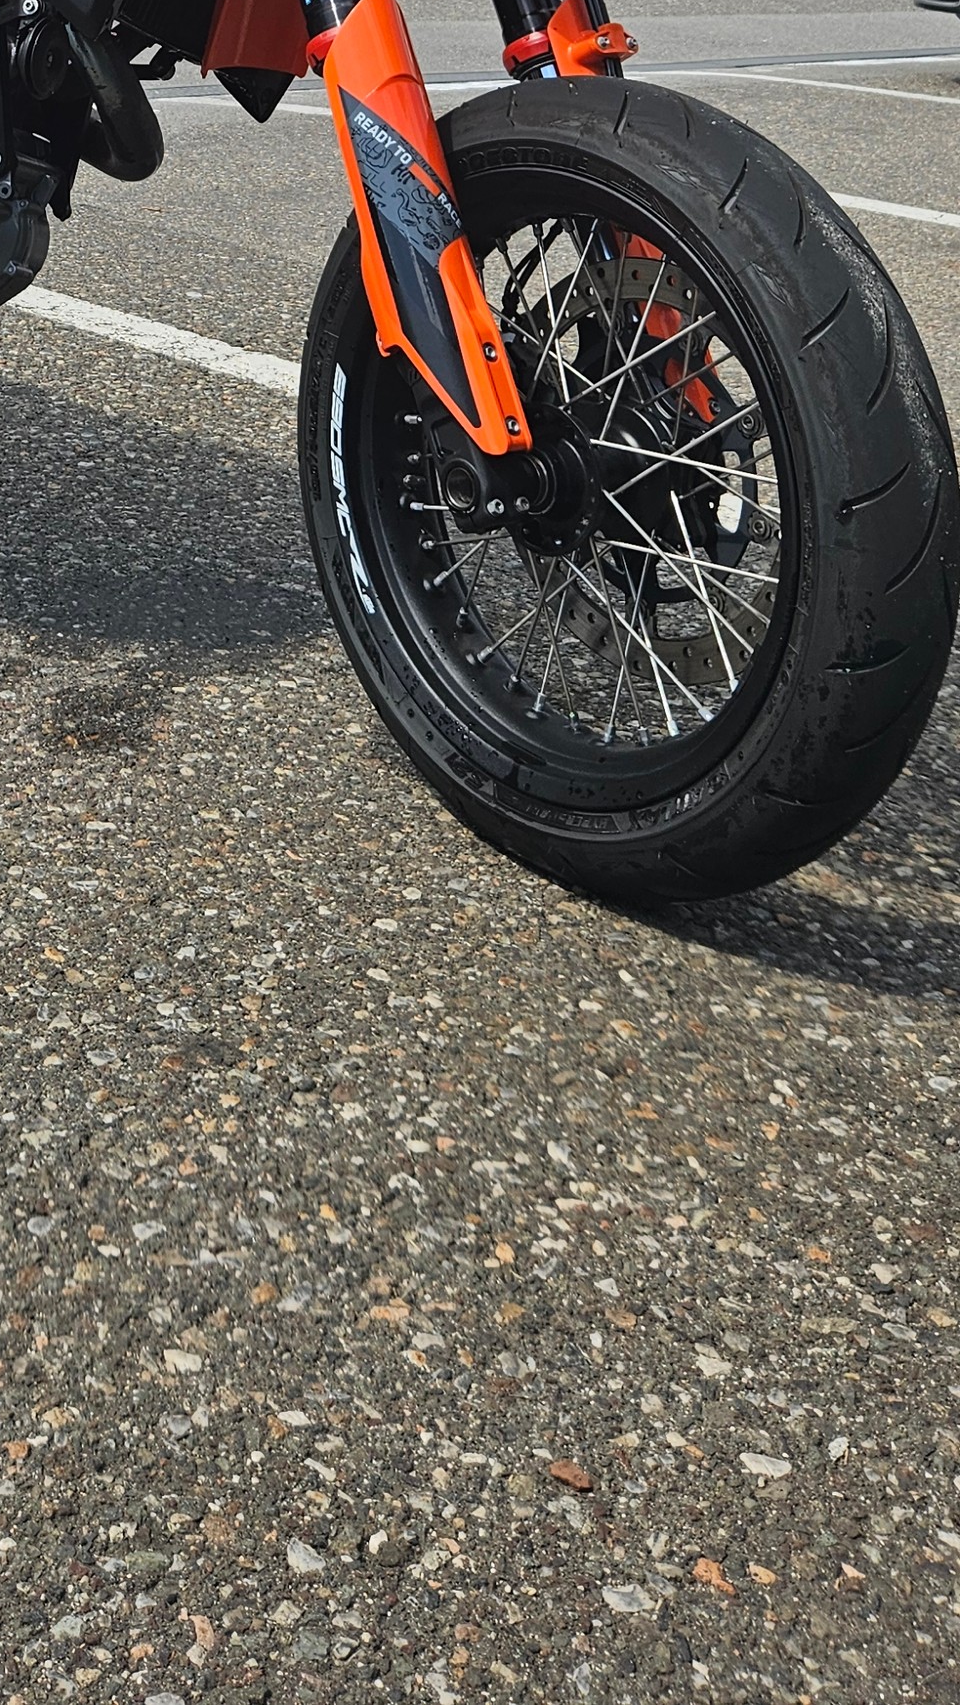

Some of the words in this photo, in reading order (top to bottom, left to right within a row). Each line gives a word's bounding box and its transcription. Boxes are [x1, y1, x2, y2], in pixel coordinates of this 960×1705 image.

[353, 111, 397, 149] READY
[394, 145, 413, 165] TO
[437, 192, 463, 229] RACE
